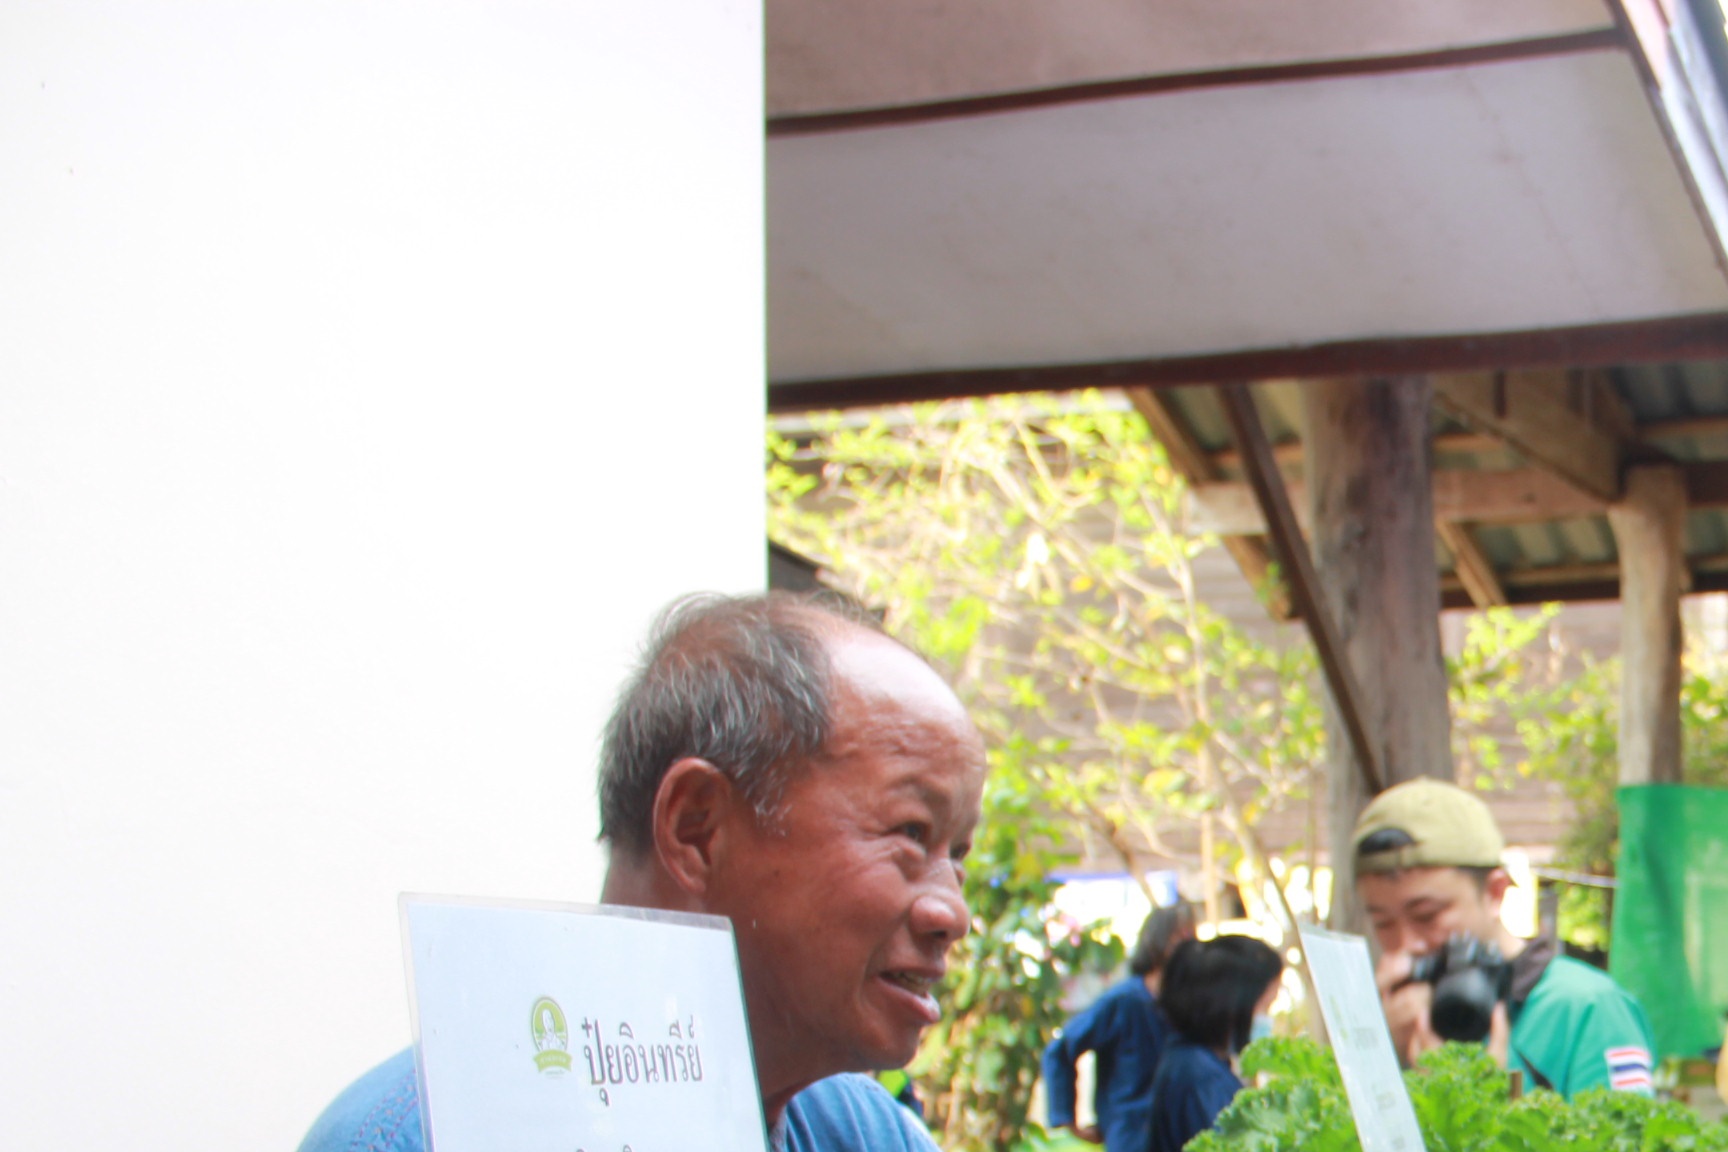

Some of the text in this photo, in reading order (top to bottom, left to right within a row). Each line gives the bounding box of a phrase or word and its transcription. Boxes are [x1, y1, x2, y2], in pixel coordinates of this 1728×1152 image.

[581, 1015, 703, 1107] ปุ๋ยอินทรีย์
